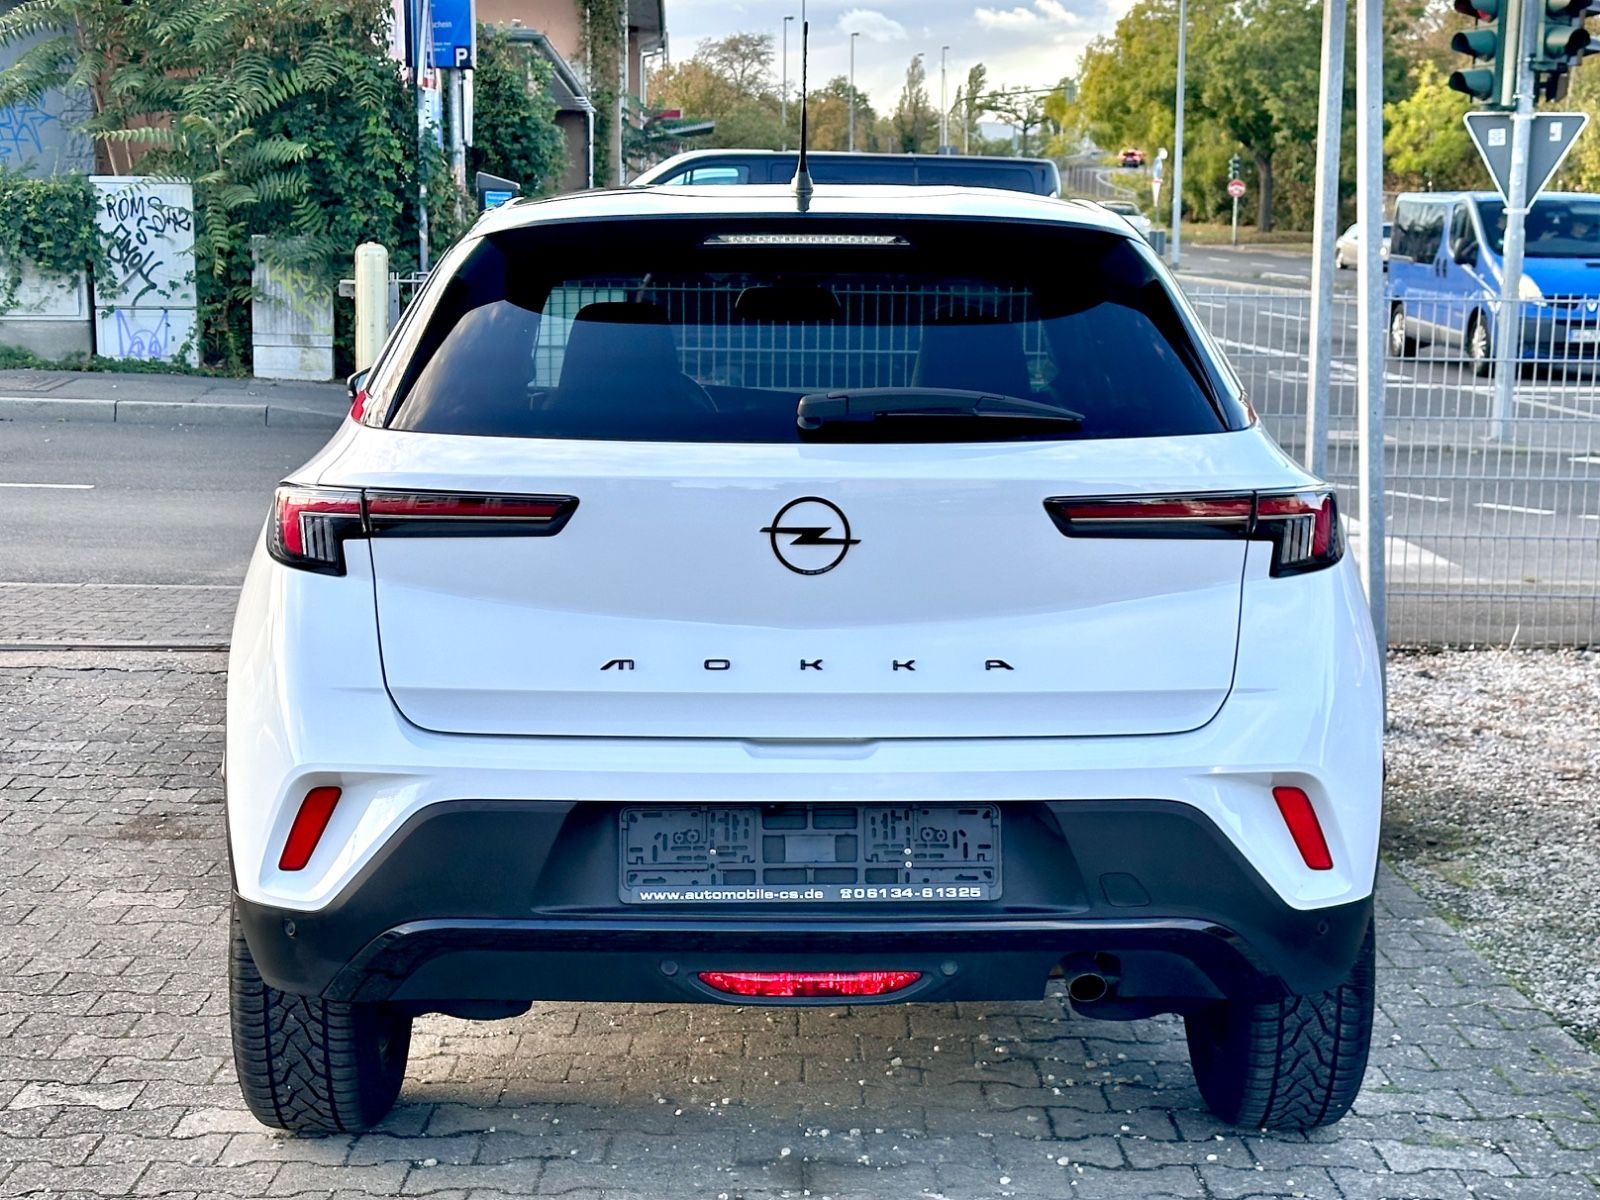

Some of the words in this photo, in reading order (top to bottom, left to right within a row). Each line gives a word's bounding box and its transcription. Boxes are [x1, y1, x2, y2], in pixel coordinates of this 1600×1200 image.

[455, 47, 468, 67] P
[600, 658, 1014, 671] MOKKA
[639, 888, 824, 901] www.automobile-cs.de
[853, 887, 981, 899] 06134-61325
